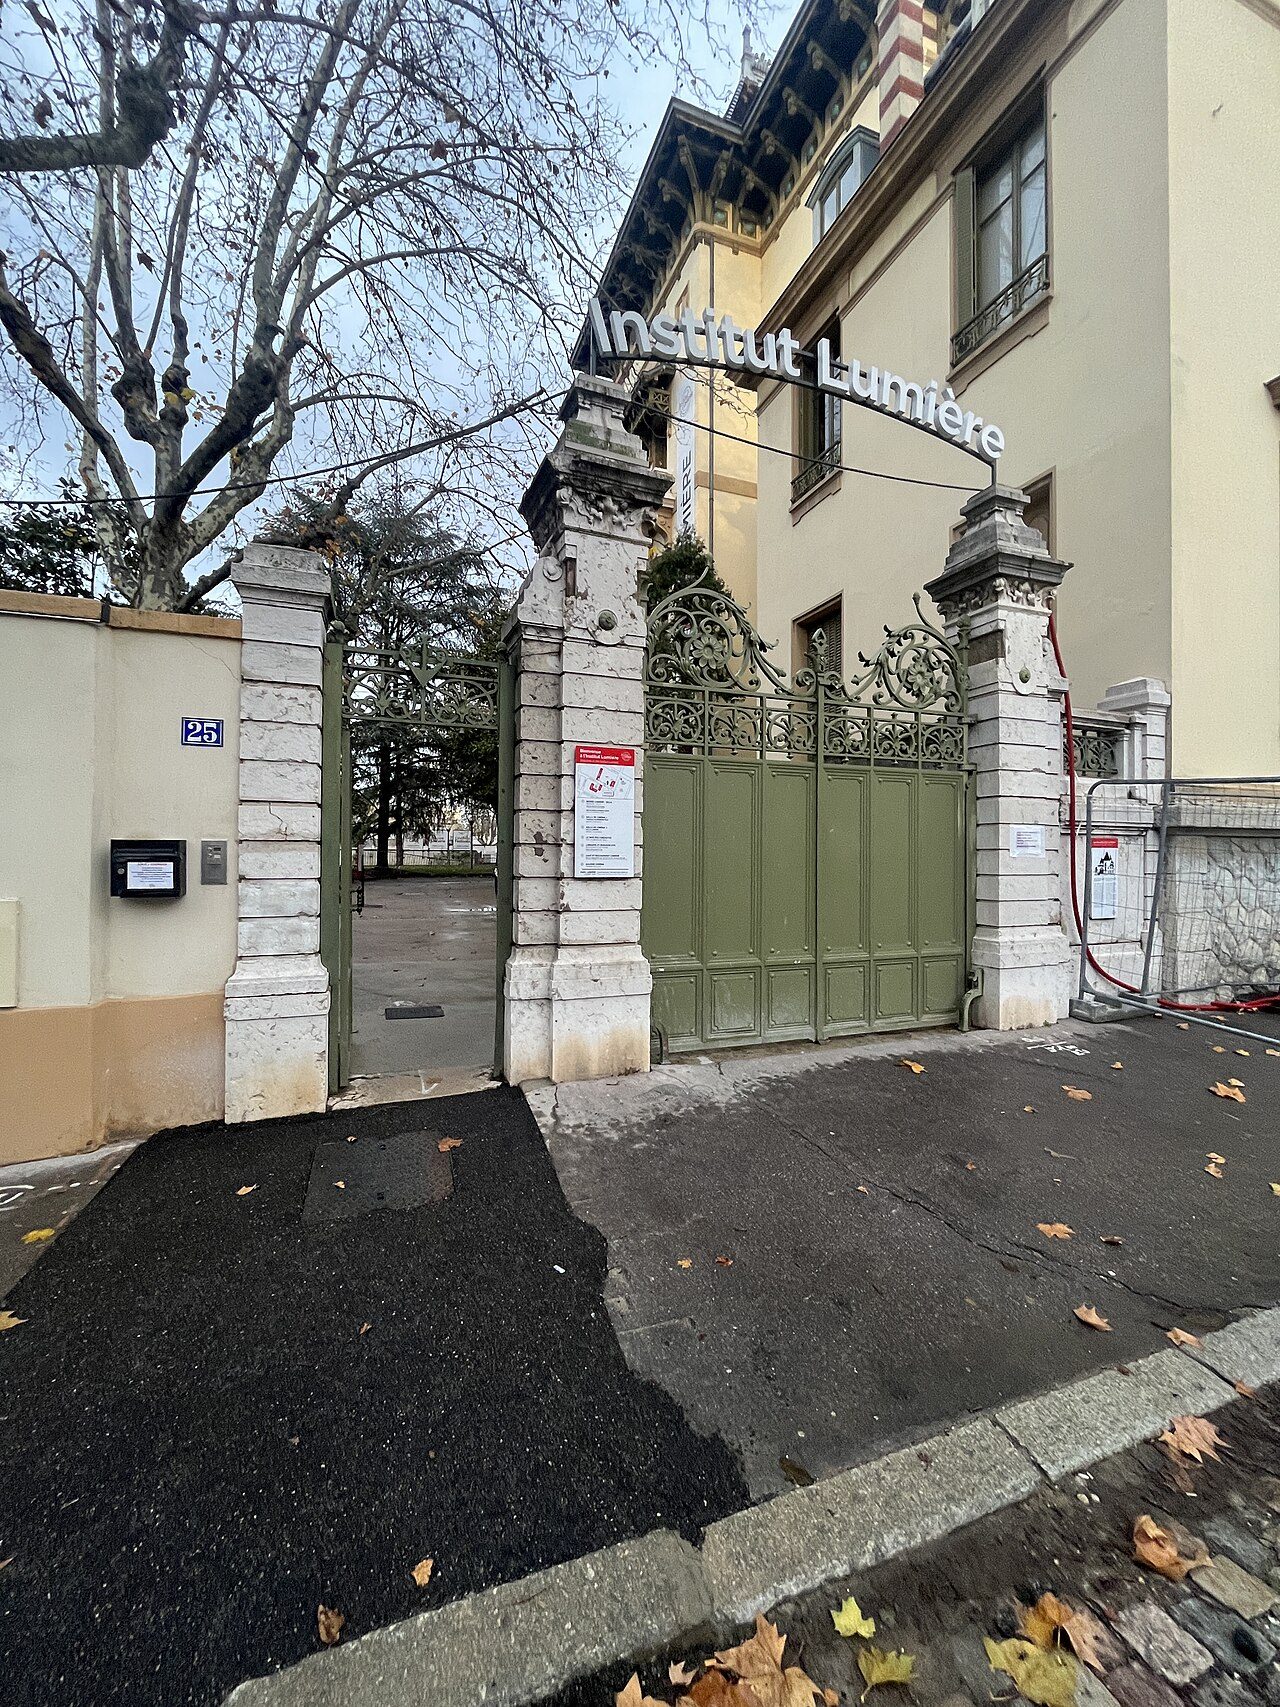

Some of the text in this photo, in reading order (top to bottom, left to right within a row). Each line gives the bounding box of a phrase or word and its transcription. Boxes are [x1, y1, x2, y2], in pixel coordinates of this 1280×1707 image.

[588, 297, 1006, 461] Institut Lumière
[187, 721, 217, 743] 25
